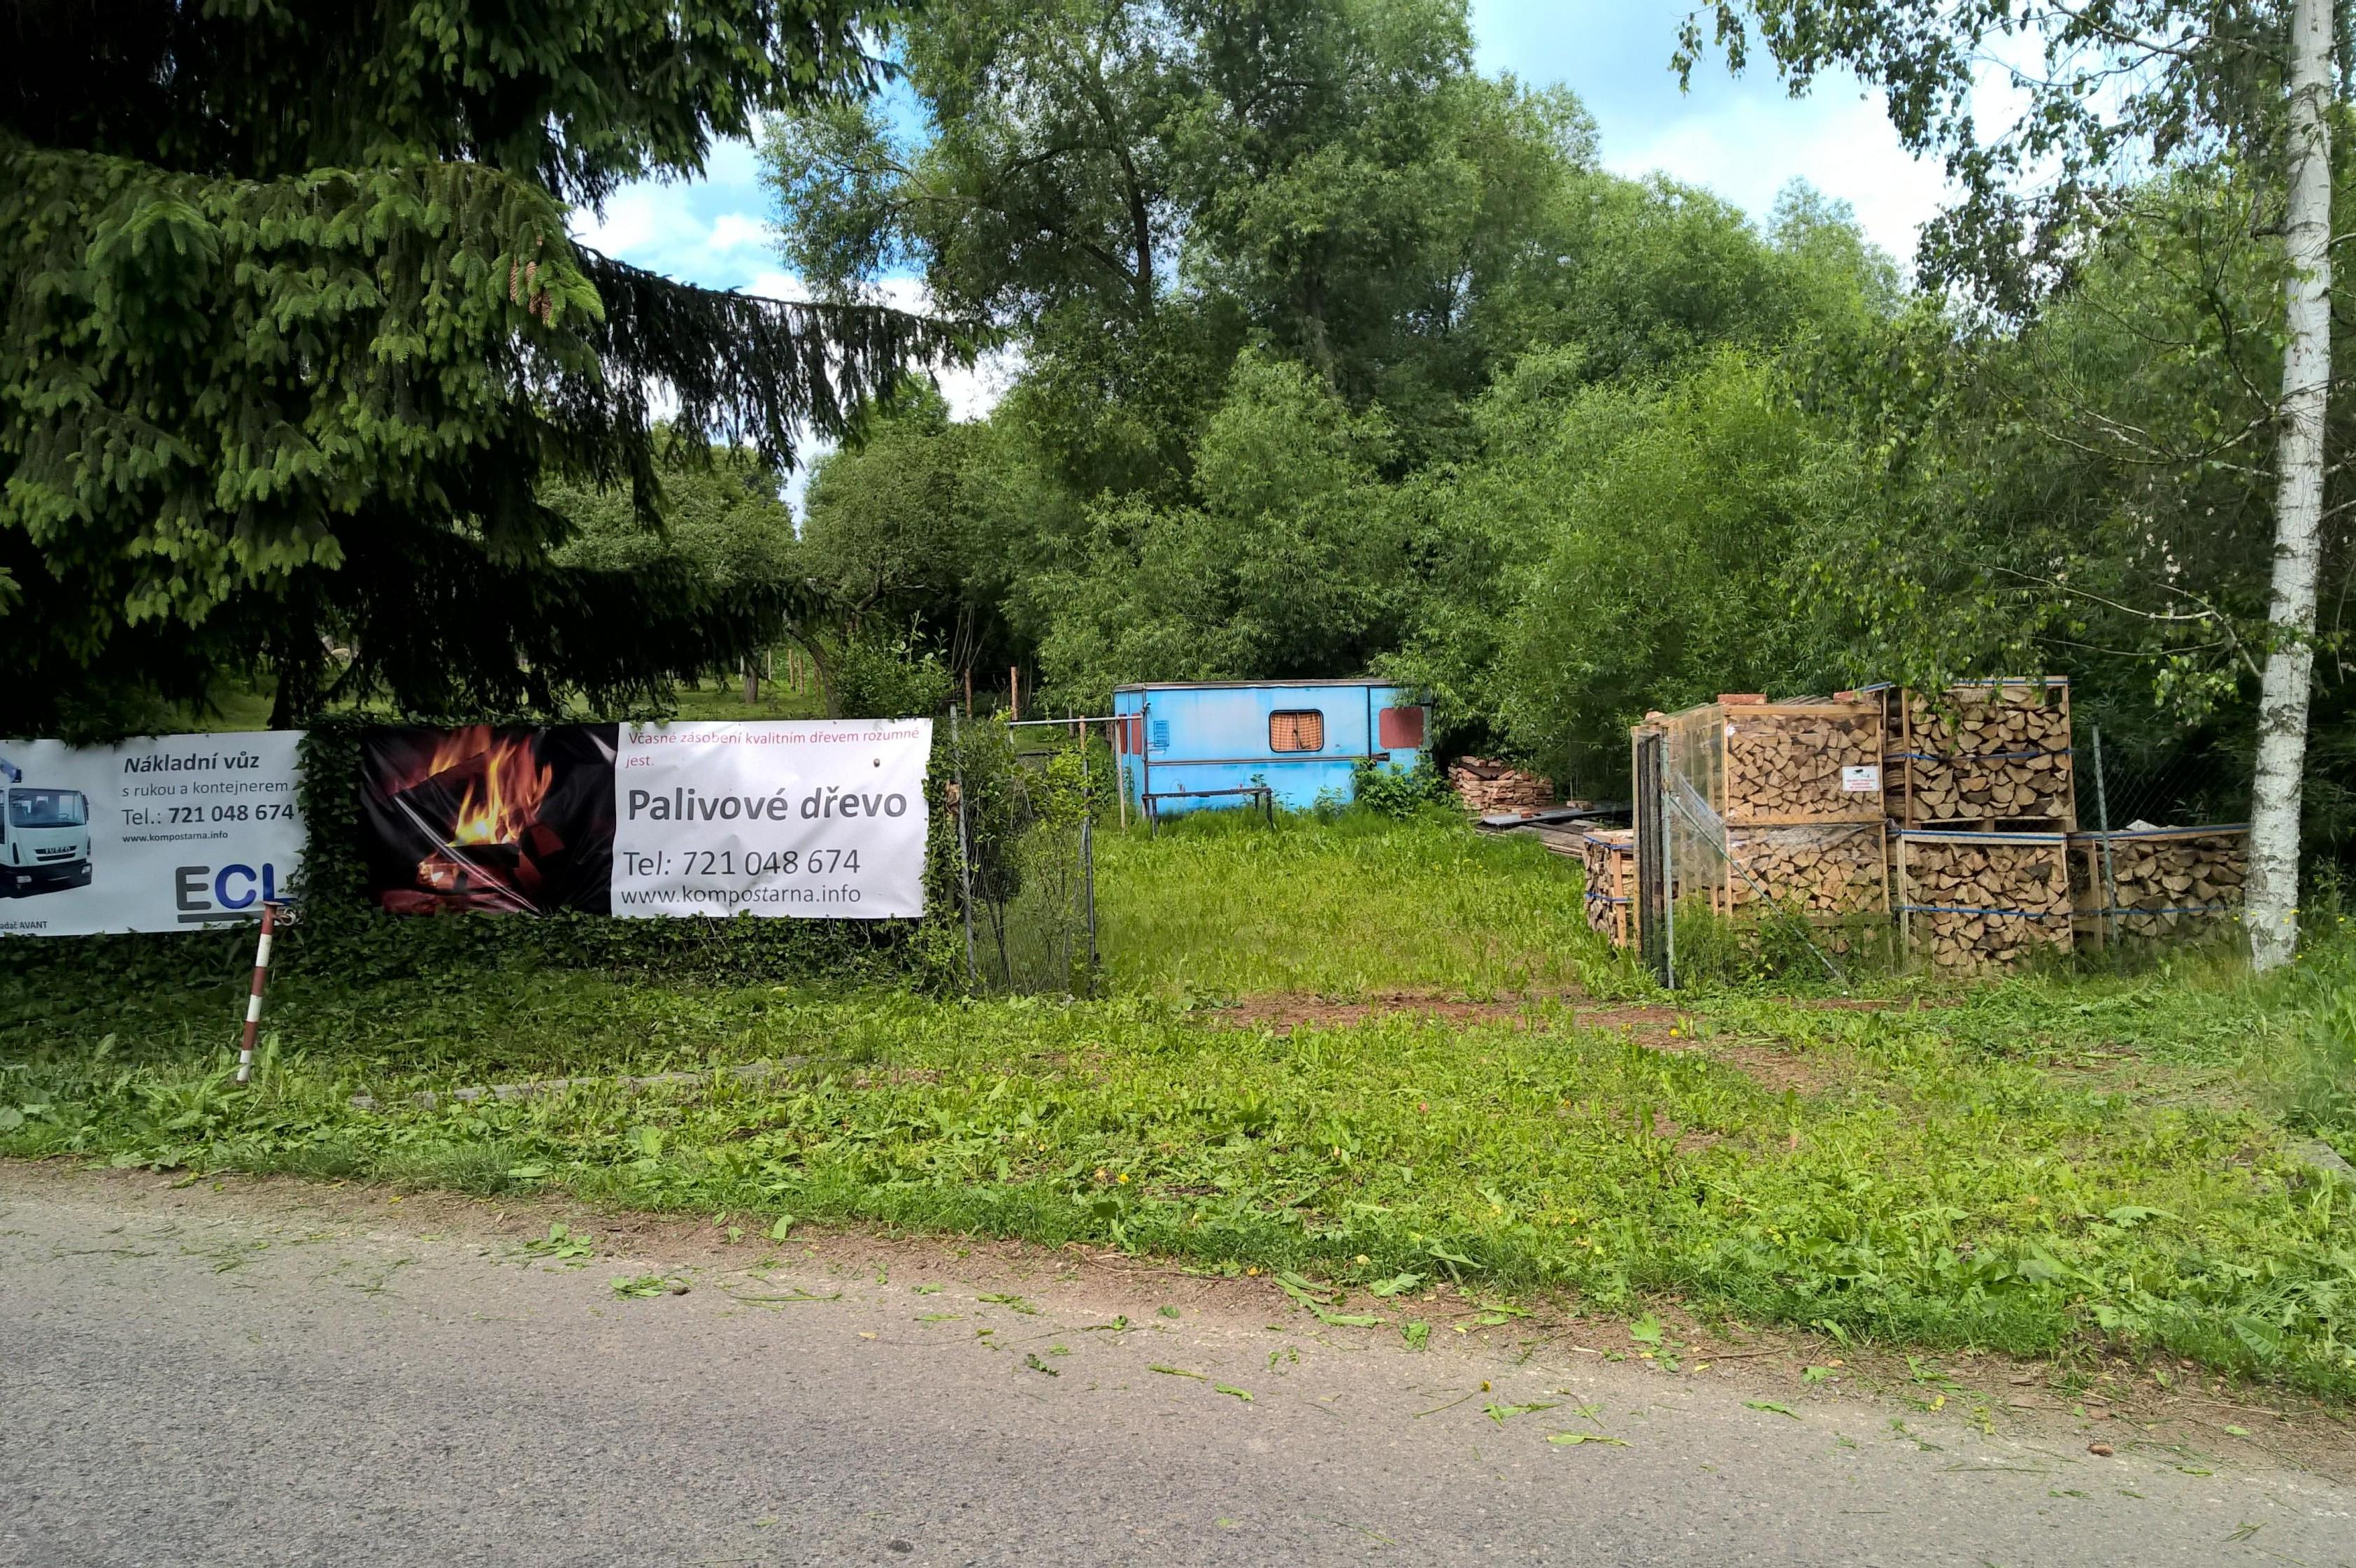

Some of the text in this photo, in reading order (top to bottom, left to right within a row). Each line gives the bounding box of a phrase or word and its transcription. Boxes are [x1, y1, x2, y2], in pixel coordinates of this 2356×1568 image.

[628, 732, 676, 745] Včasné
[680, 731, 741, 745] zásobení
[745, 732, 805, 745] kvalitním
[810, 731, 859, 743] dřevem
[124, 750, 259, 773] Nákladní vůz
[625, 755, 654, 769] jest.
[122, 781, 288, 797] s rukou a kontejnerem
[629, 785, 907, 821] Palivové dřevo
[121, 804, 294, 825] Tel.: 721 048 674
[122, 831, 229, 842] www.kompostarna.info
[623, 849, 861, 876] Tel: 721 048 674
[176, 863, 299, 911] ECL
[620, 883, 861, 907] www.kompostarna.info
[20, 920, 48, 929] AVANT
